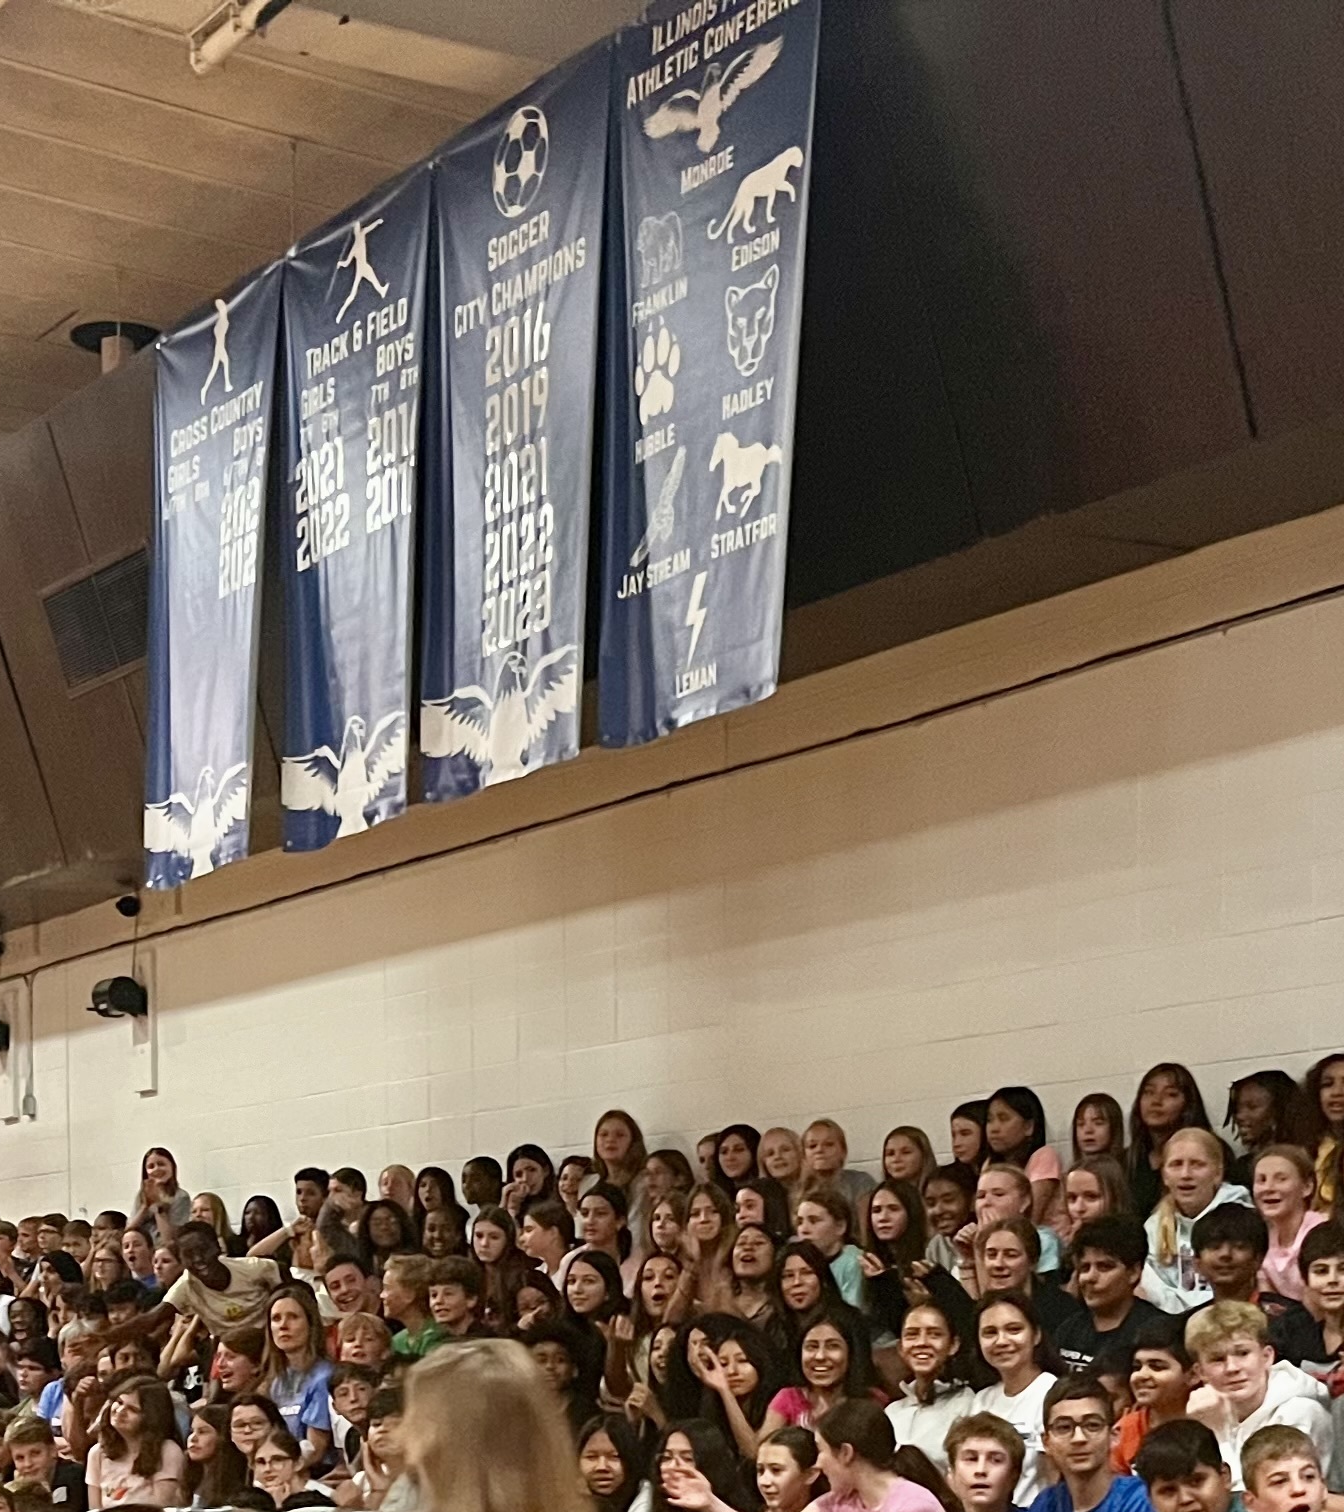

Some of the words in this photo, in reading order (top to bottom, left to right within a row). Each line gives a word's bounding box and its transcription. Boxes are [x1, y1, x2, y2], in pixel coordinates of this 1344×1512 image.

[652, 0, 716, 55] ILLINOIS
[627, 41, 699, 109] ATHLETIC
[681, 145, 734, 194] MONROE
[487, 210, 550, 272] SOCCER
[731, 227, 780, 272] EDISON
[455, 292, 488, 339] CITY
[492, 236, 586, 316] CHAMPIONS
[632, 276, 688, 327] FRANKLIN
[306, 330, 349, 379] TRACK
[367, 297, 407, 344] FIELD
[377, 332, 414, 377] BOYS
[485, 301, 551, 387] 2016
[171, 416, 208, 458] CROSS
[211, 381, 263, 434] COUNTRY
[301, 377, 335, 419] GIRLS
[485, 366, 549, 456] 2019
[722, 376, 775, 421] HADLEY
[233, 417, 263, 456] BOYS
[296, 436, 344, 514] 2021
[485, 437, 548, 522] 2021
[297, 493, 349, 572] 2022
[711, 512, 777, 559] STRATFOR
[617, 571, 646, 599] JAY
[646, 548, 691, 588] STREAM
[482, 571, 551, 657] 2023
[676, 662, 717, 699] LEMAN
